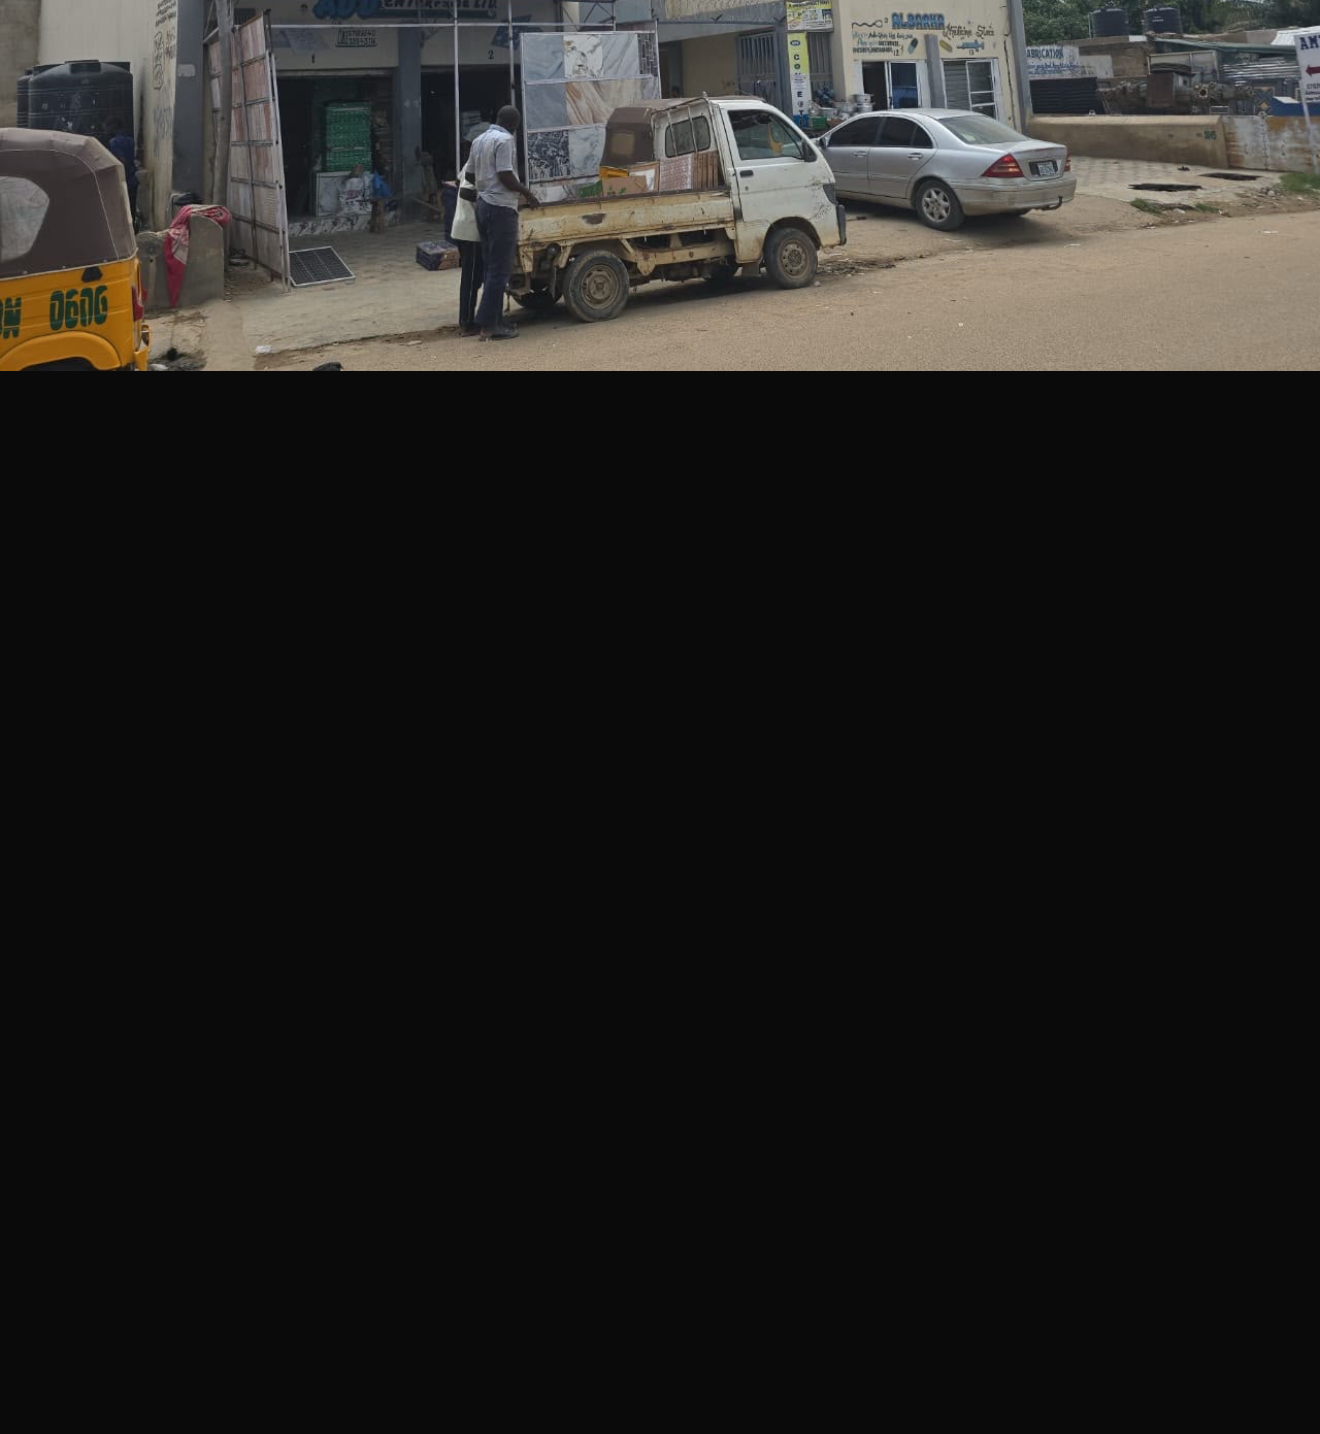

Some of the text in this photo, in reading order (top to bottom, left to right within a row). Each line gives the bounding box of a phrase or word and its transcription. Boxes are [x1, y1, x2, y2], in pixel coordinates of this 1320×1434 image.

[1300, 35, 1320, 50] AM
[487, 49, 495, 60] 2
[49, 284, 108, 331] 0606
